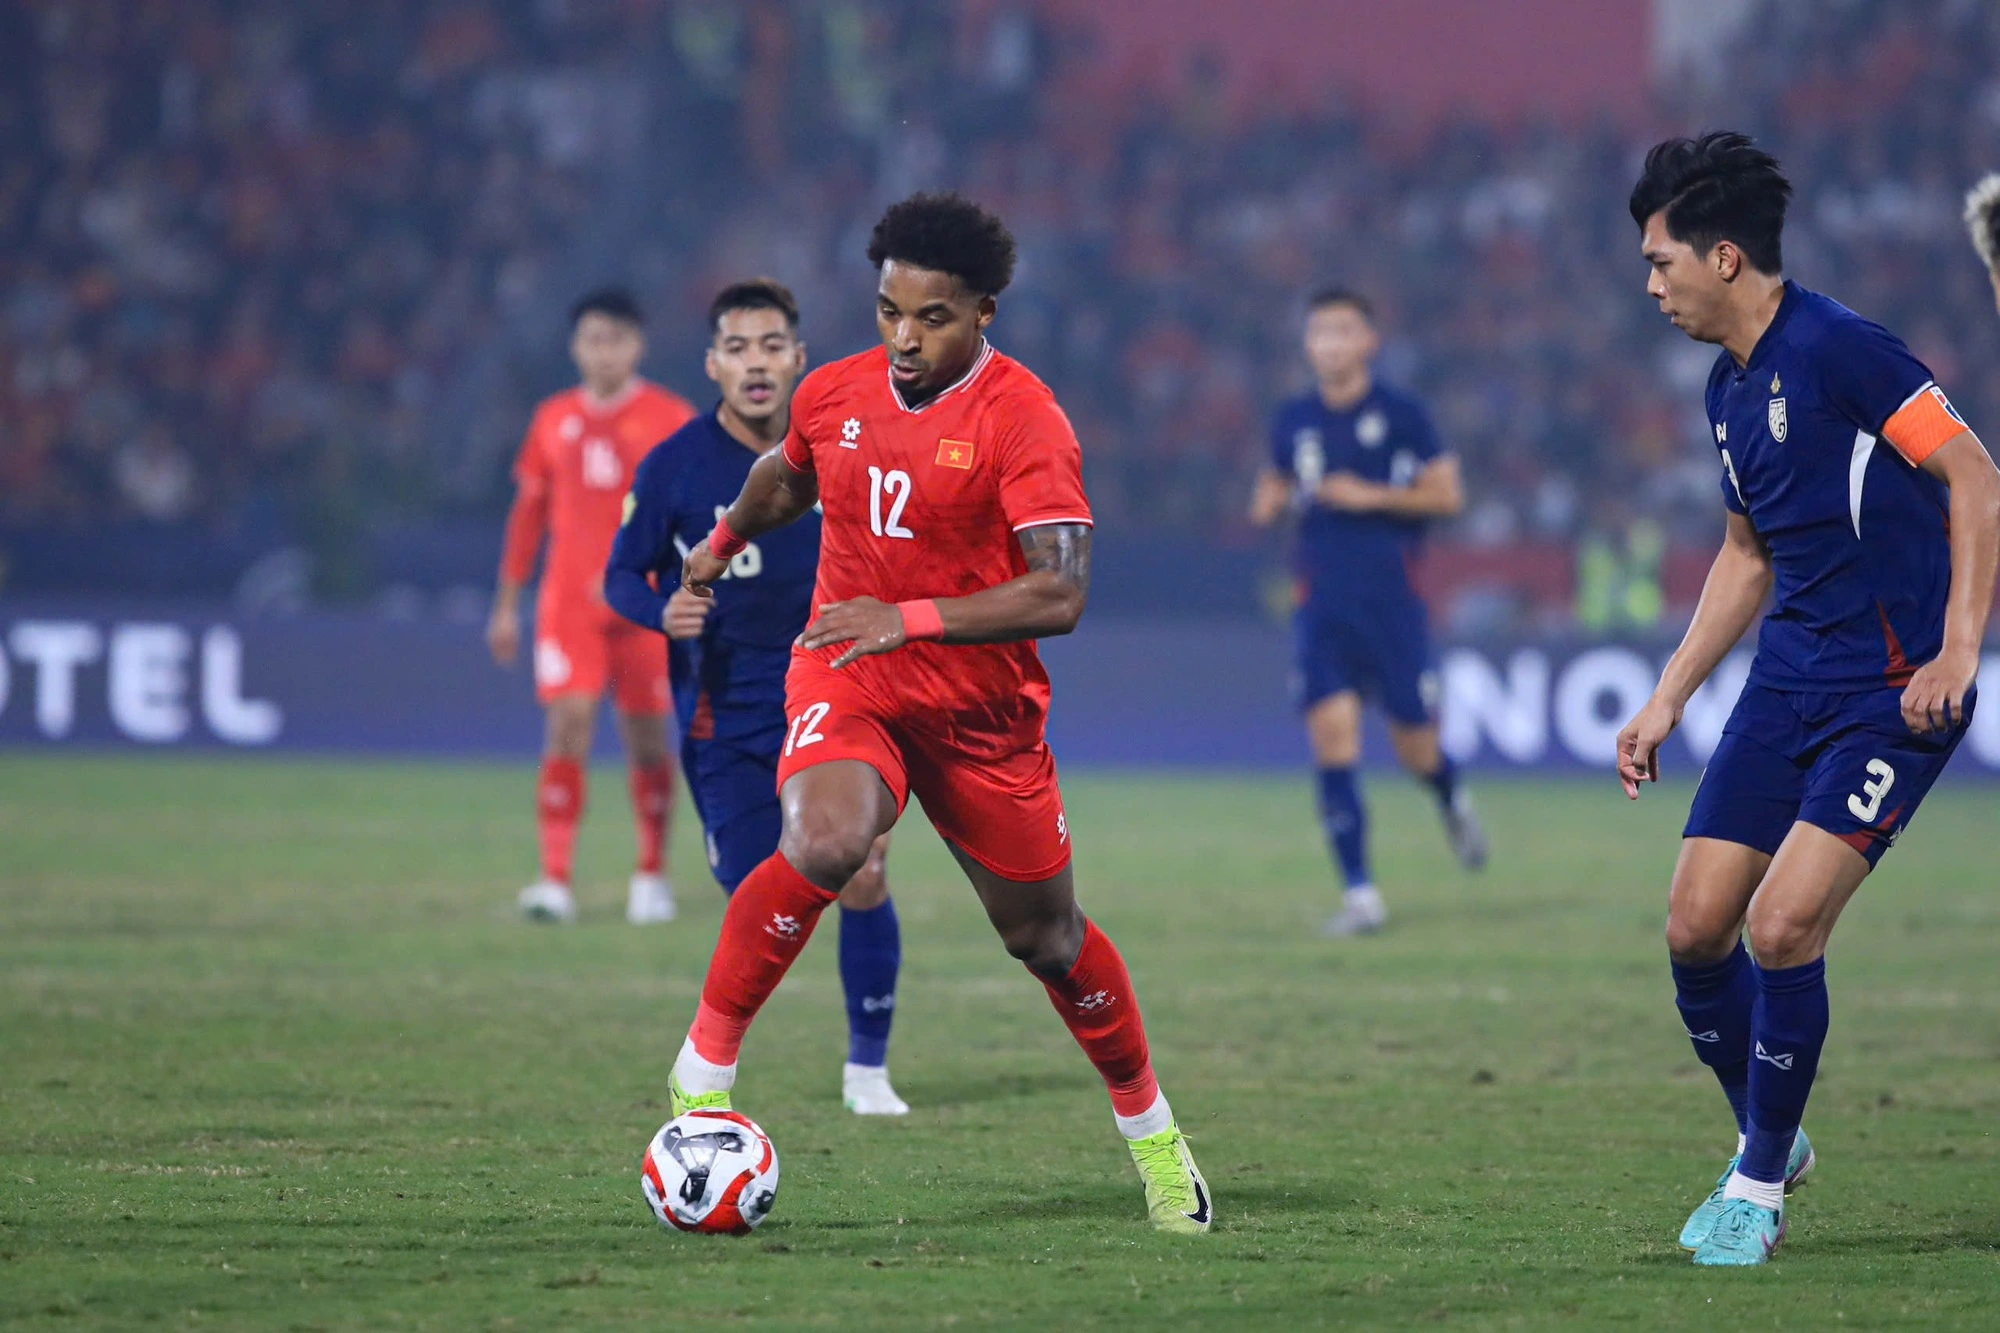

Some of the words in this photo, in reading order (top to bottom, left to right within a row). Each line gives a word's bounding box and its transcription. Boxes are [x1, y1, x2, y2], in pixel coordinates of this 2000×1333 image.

[868, 465, 914, 539] 12
[0, 620, 284, 743] TEL
[785, 702, 830, 757] 12
[1847, 758, 1895, 823] 3
